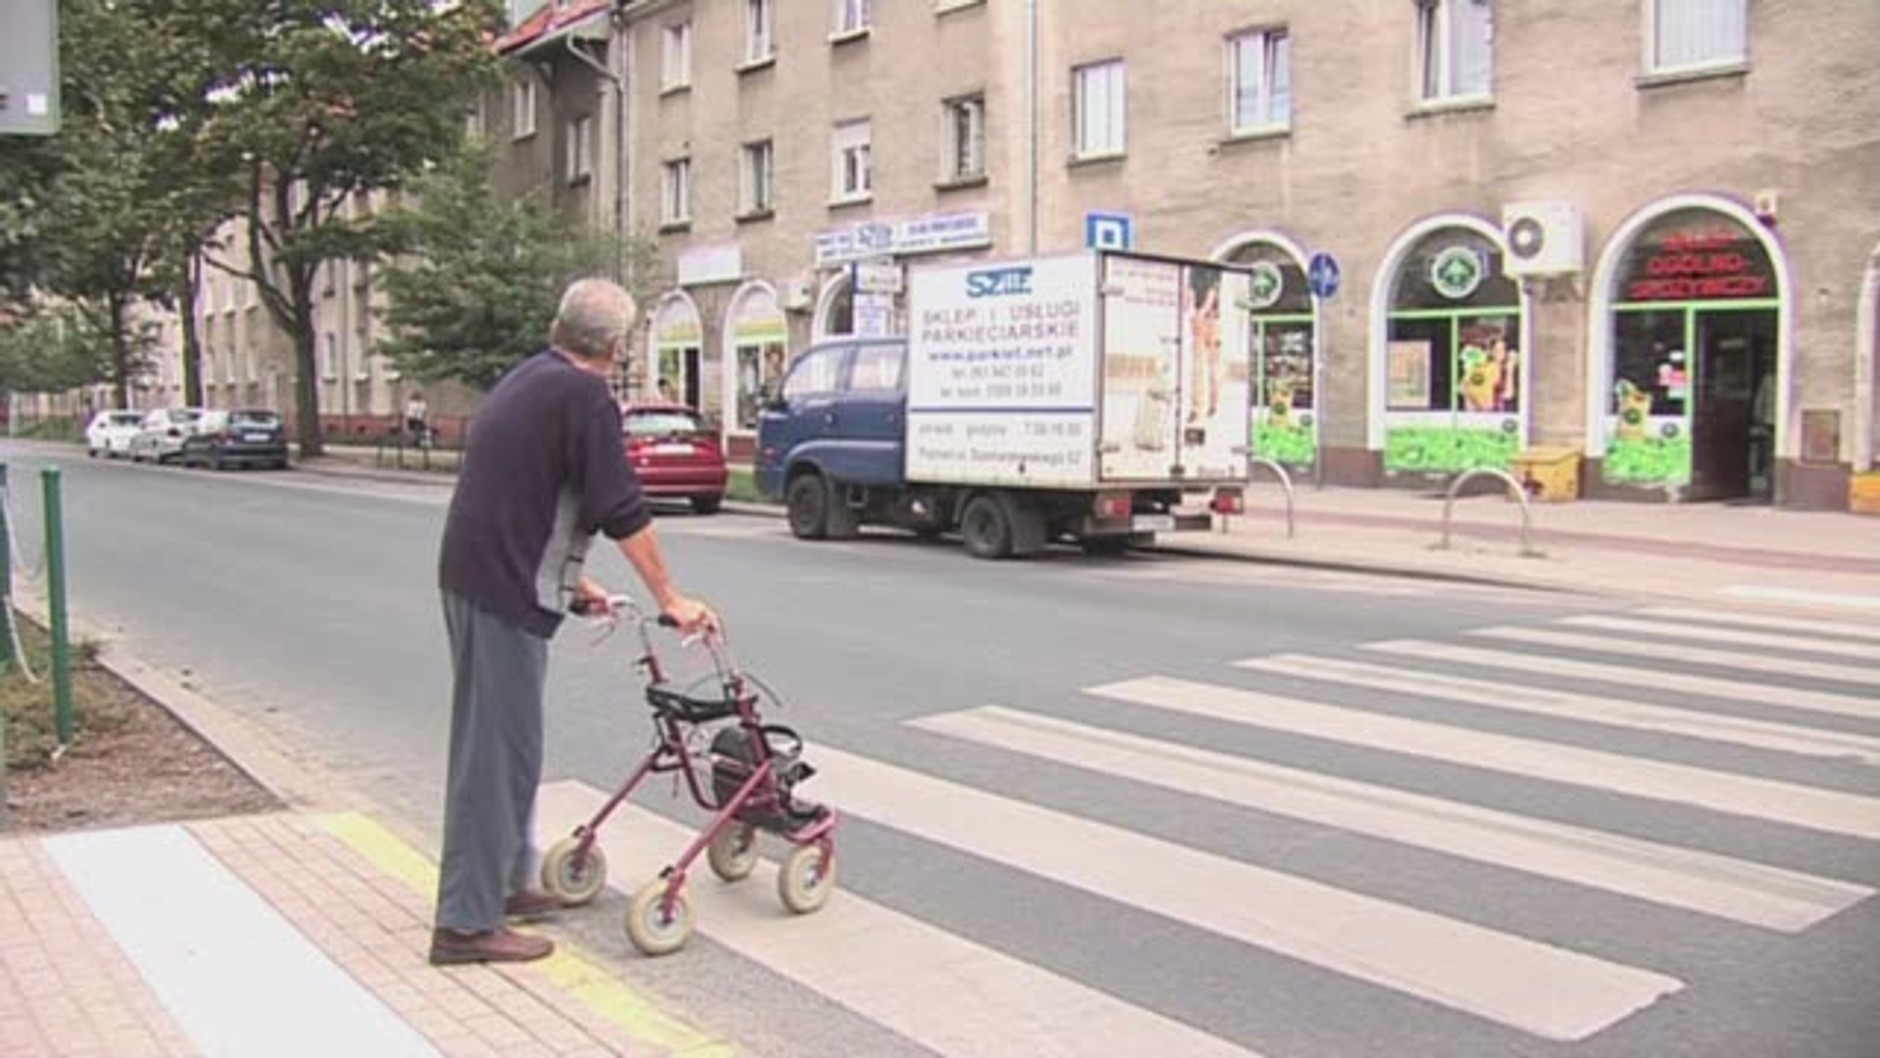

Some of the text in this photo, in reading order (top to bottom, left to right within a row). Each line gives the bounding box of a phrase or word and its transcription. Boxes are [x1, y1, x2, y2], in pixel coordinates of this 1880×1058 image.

[923, 308, 977, 325] SKLEP
[1009, 300, 1081, 321] USŁUGI
[921, 320, 1080, 343] PARKIECIARSKIE
